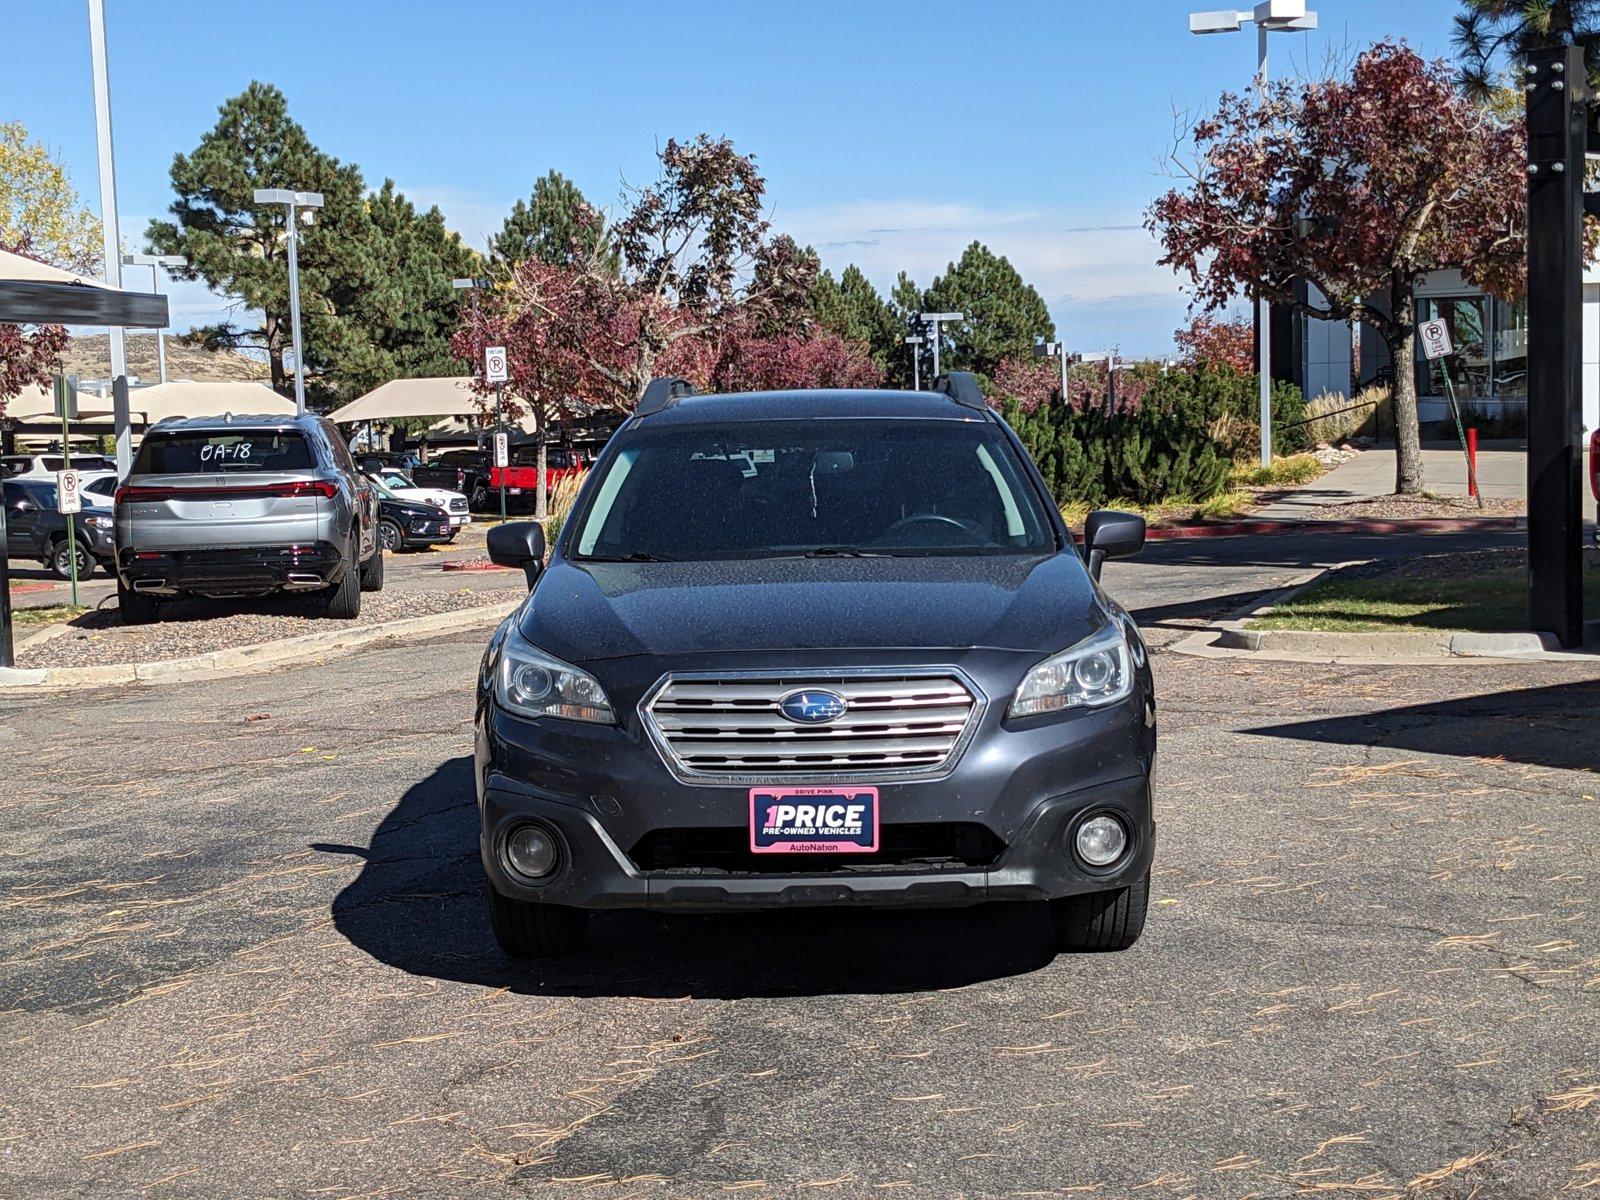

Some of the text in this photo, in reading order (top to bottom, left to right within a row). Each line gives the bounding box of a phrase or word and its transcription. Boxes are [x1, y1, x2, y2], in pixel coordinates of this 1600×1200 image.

[762, 827, 862, 835] PRE-OWNED VEHICLES
[789, 843, 838, 852] AutoNation
